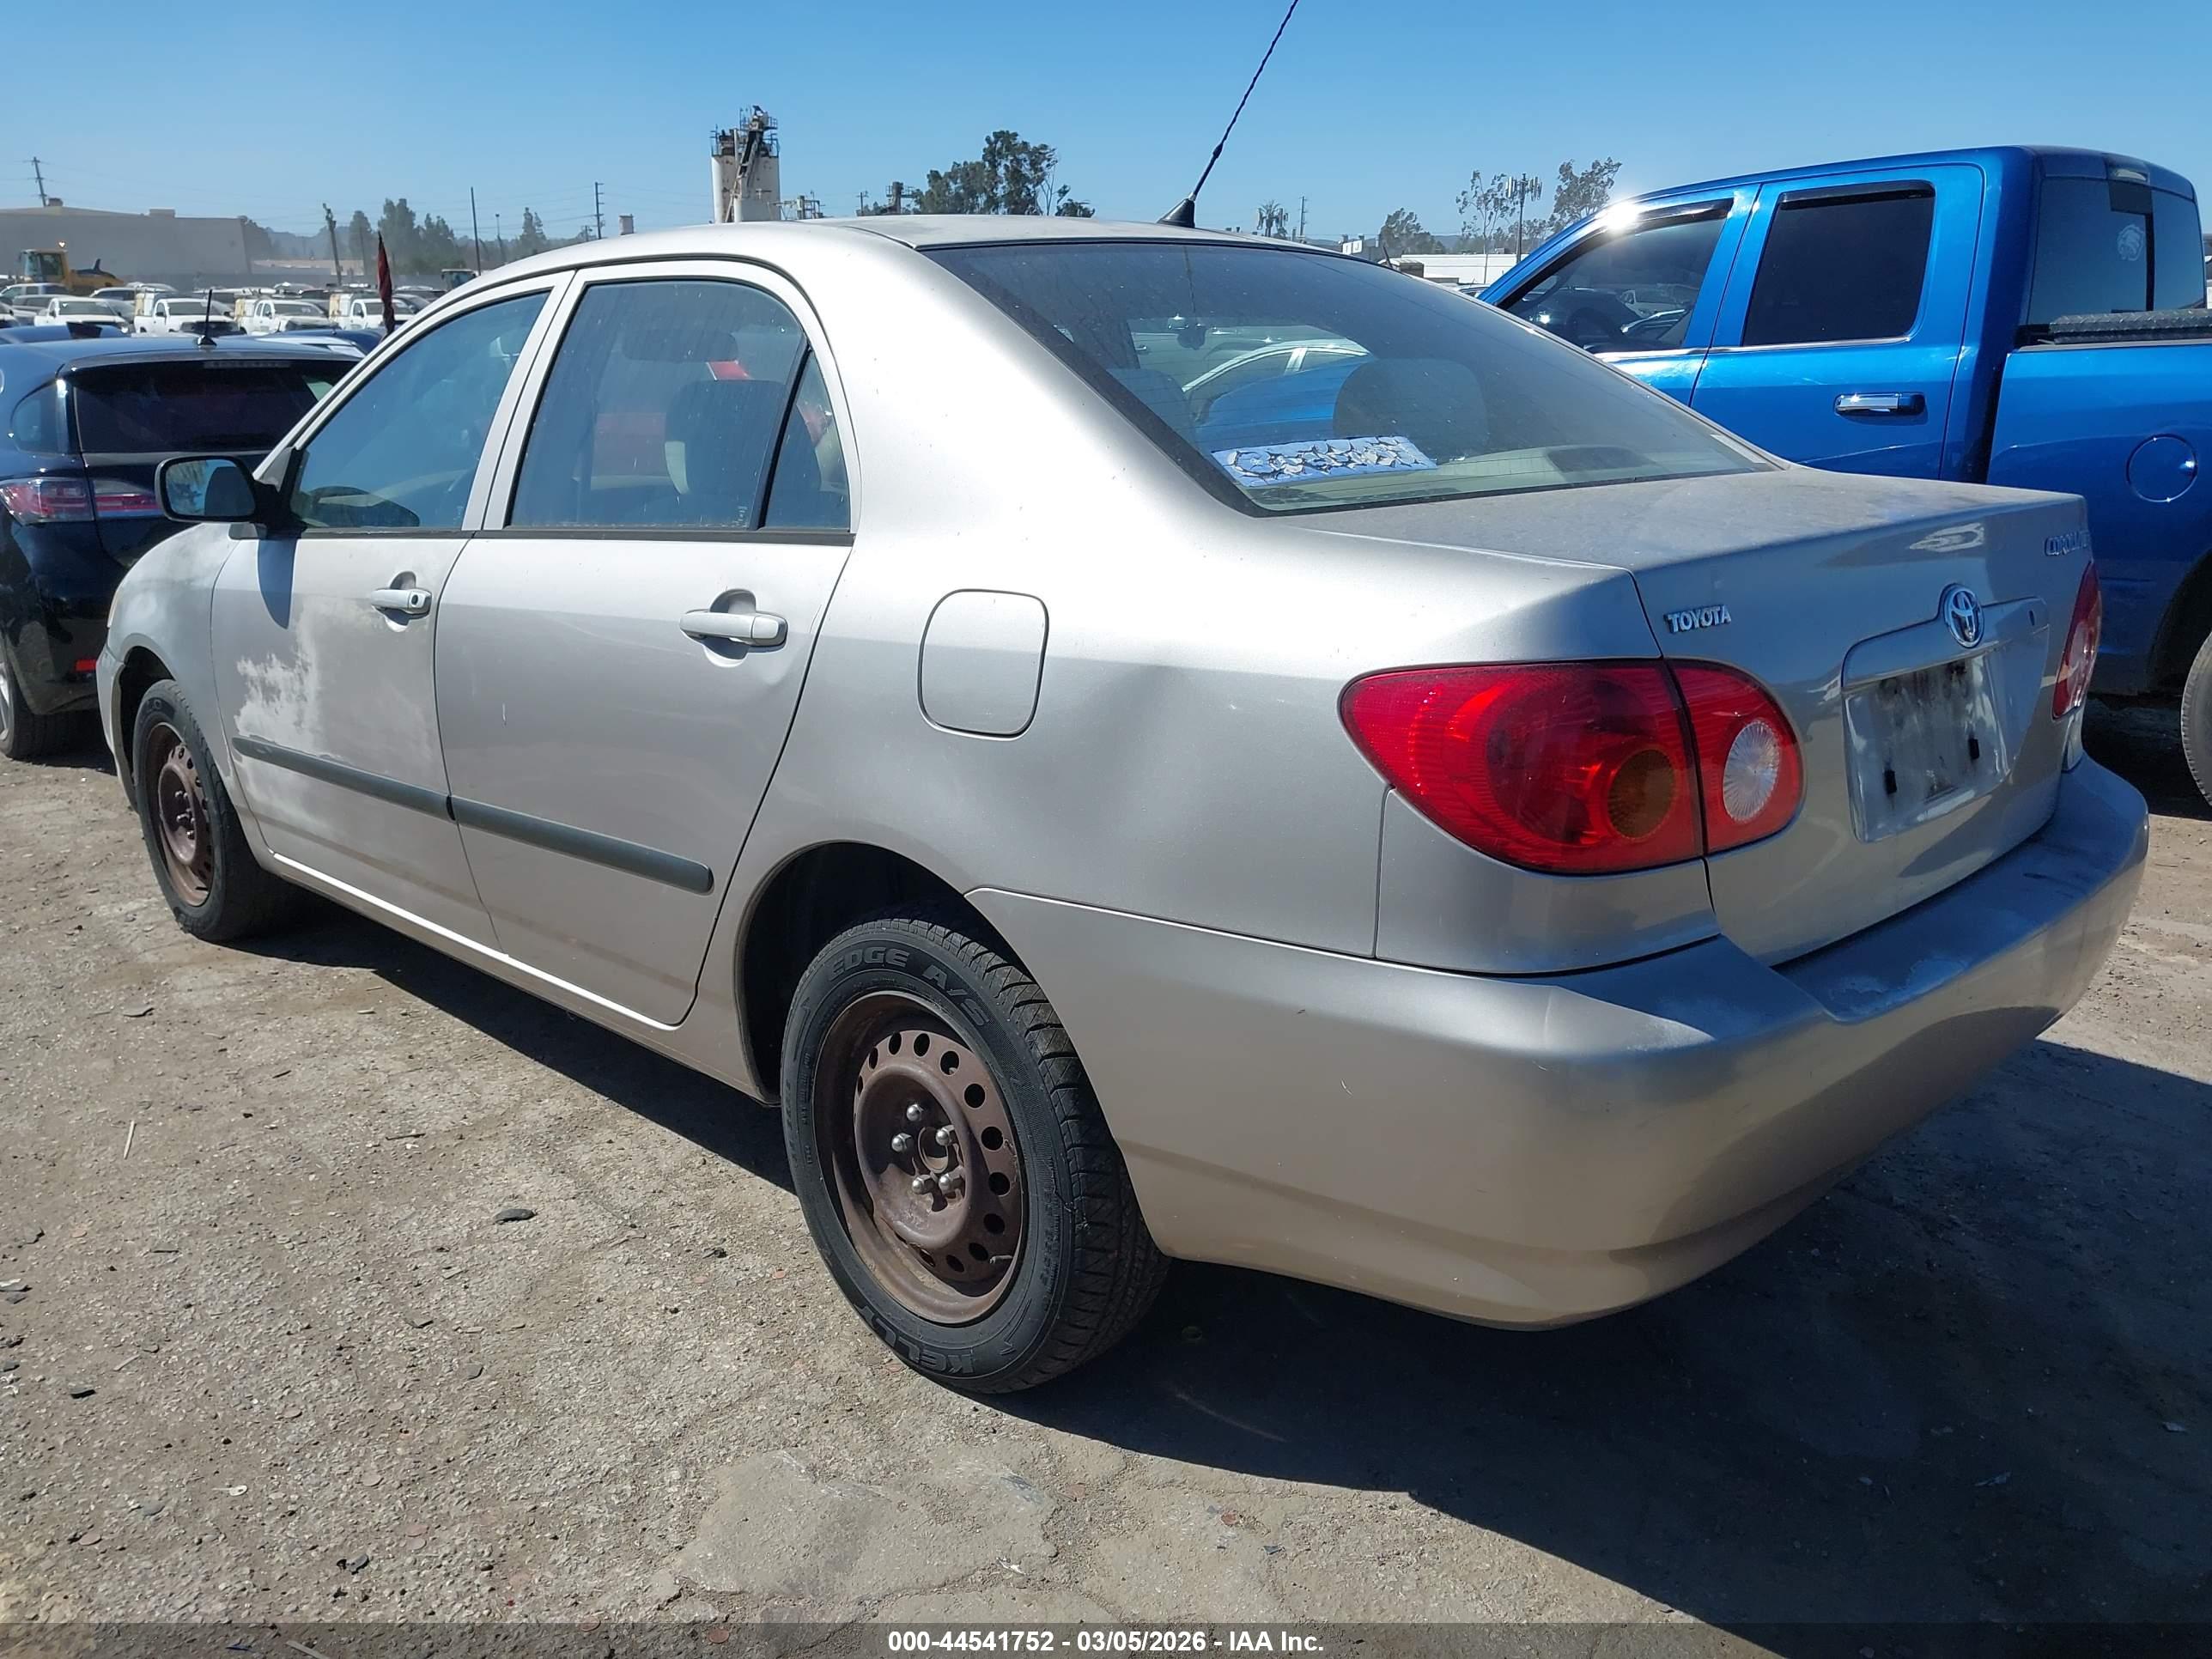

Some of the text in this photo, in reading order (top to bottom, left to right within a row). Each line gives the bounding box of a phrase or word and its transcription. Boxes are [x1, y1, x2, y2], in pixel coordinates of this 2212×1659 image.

[1665, 605, 1732, 633] TOYOTA
[829, 946, 990, 1026] EDGE A/S
[854, 1304, 975, 1374] KELLY
